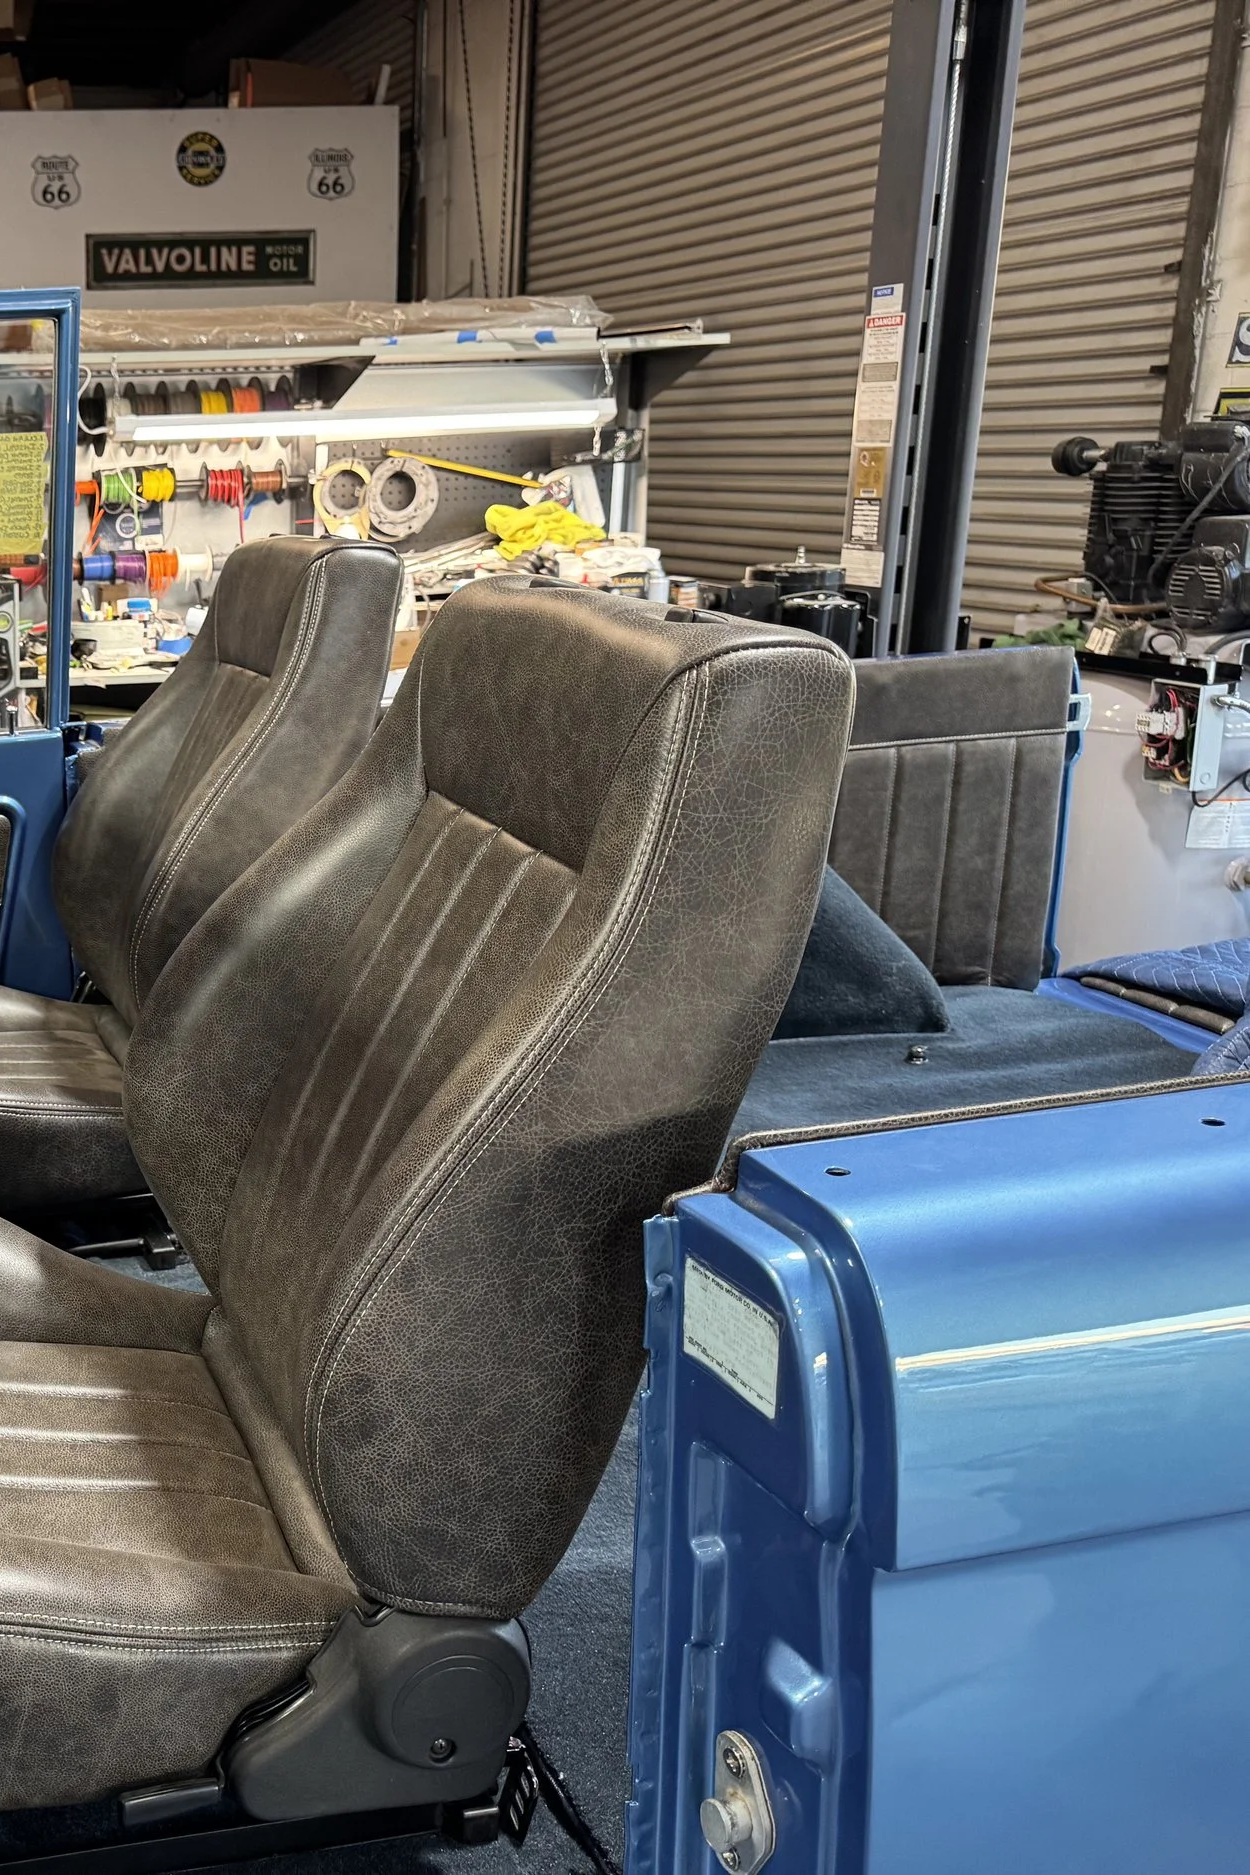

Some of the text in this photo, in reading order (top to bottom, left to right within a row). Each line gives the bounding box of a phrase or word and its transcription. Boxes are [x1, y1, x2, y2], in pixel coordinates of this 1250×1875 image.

[41, 160, 70, 171] ROUTE
[313, 153, 350, 163] ILLINOIS
[317, 176, 345, 195] 66
[42, 184, 71, 204] 66
[265, 244, 304, 256] MOTOR
[100, 245, 257, 274] VALVOLINE
[269, 257, 298, 272] OIL
[874, 316, 901, 327] DANGER
[711, 1277, 724, 1291] FORD
[724, 1286, 743, 1304] MOTOR
